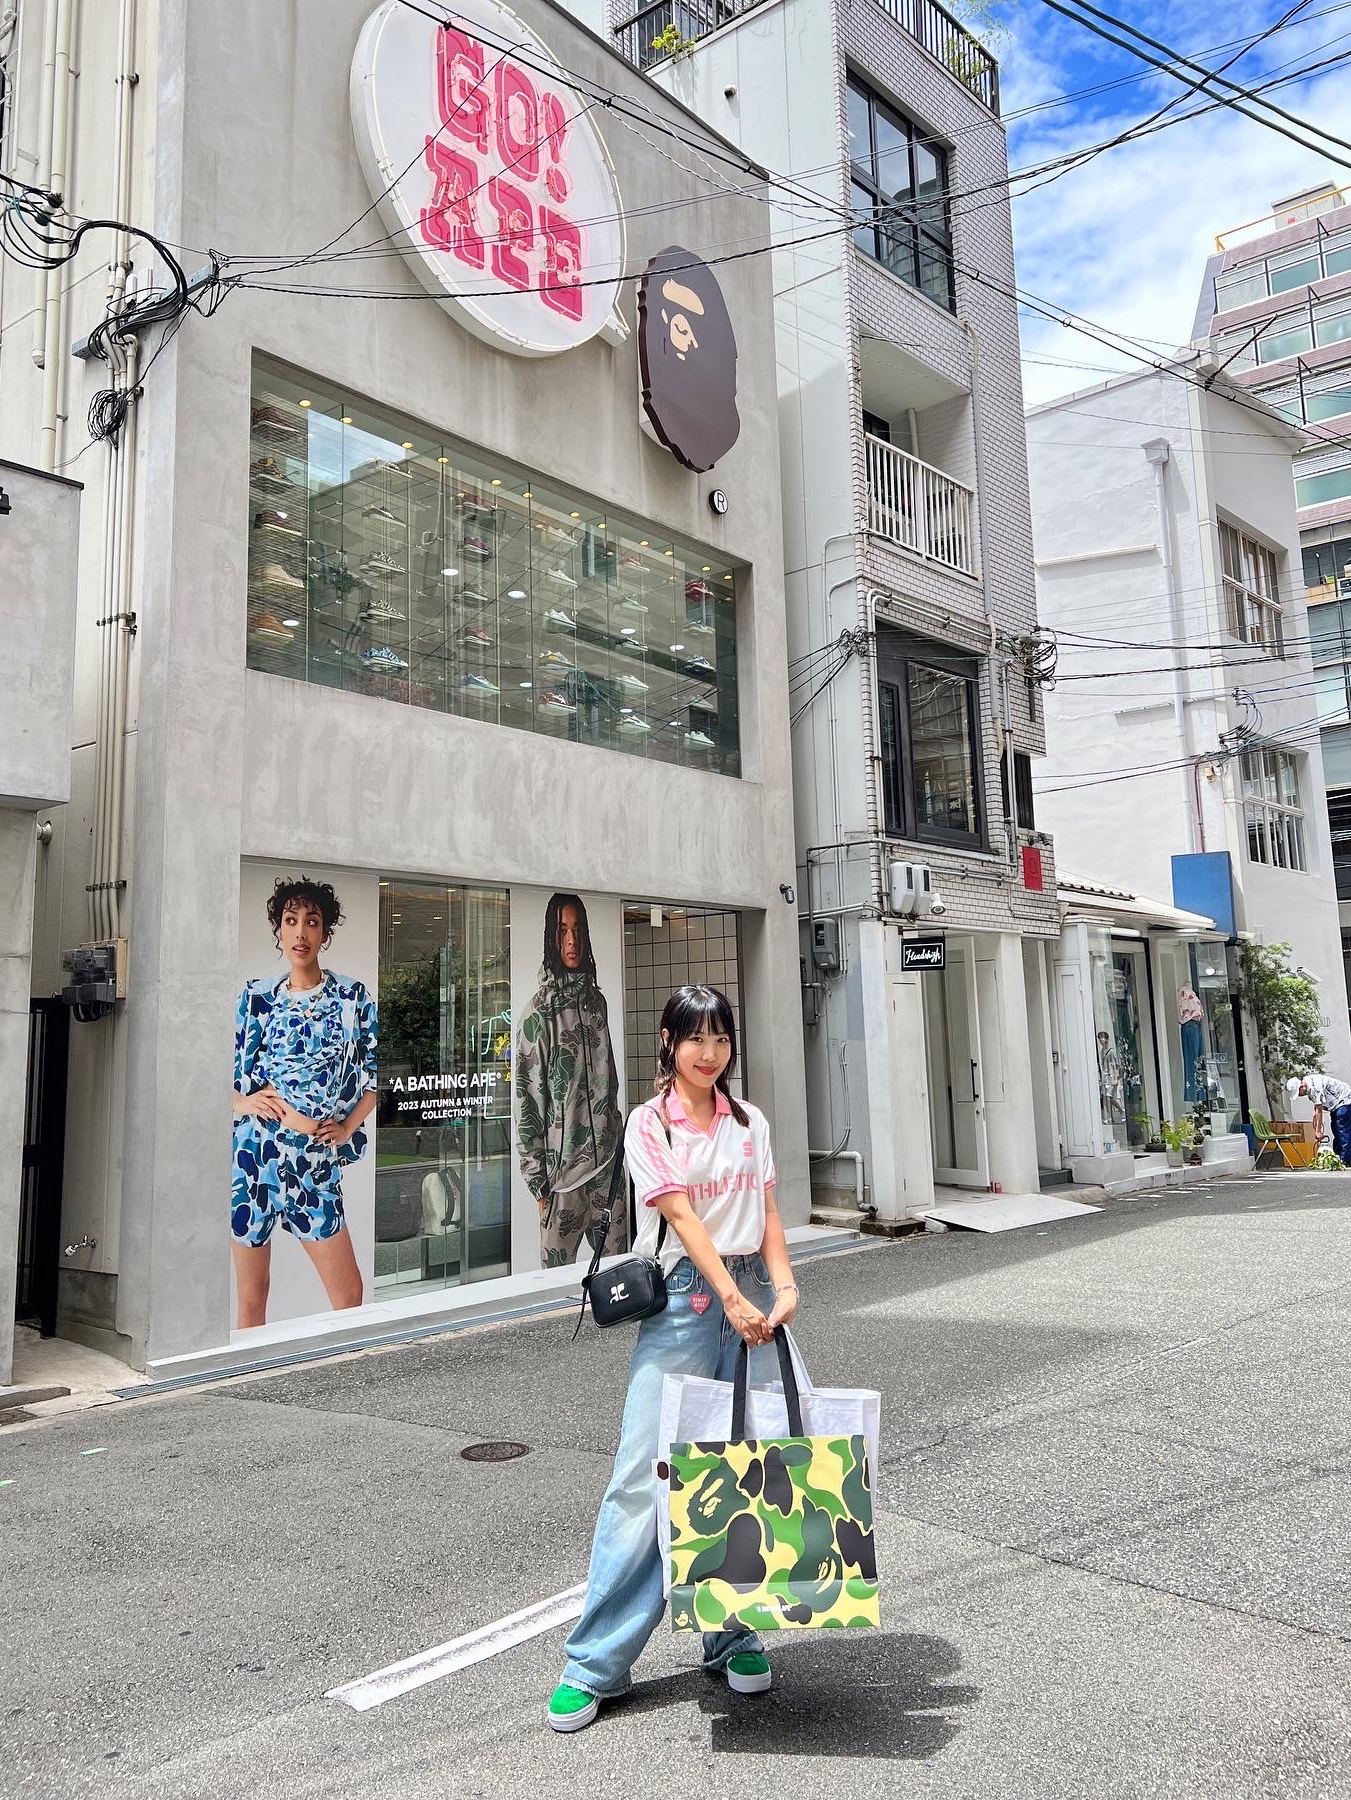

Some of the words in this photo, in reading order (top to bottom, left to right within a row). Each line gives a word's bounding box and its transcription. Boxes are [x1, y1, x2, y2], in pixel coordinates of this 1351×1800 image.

[434, 18, 573, 206] GO!
[407, 1073, 467, 1092] BATHING
[397, 1101, 419, 1111] 2023
[420, 1099, 455, 1109] AUTUMN
[456, 1098, 461, 1106] &
[463, 1096, 493, 1106] WINTER
[421, 1108, 472, 1120] COLLECTION
